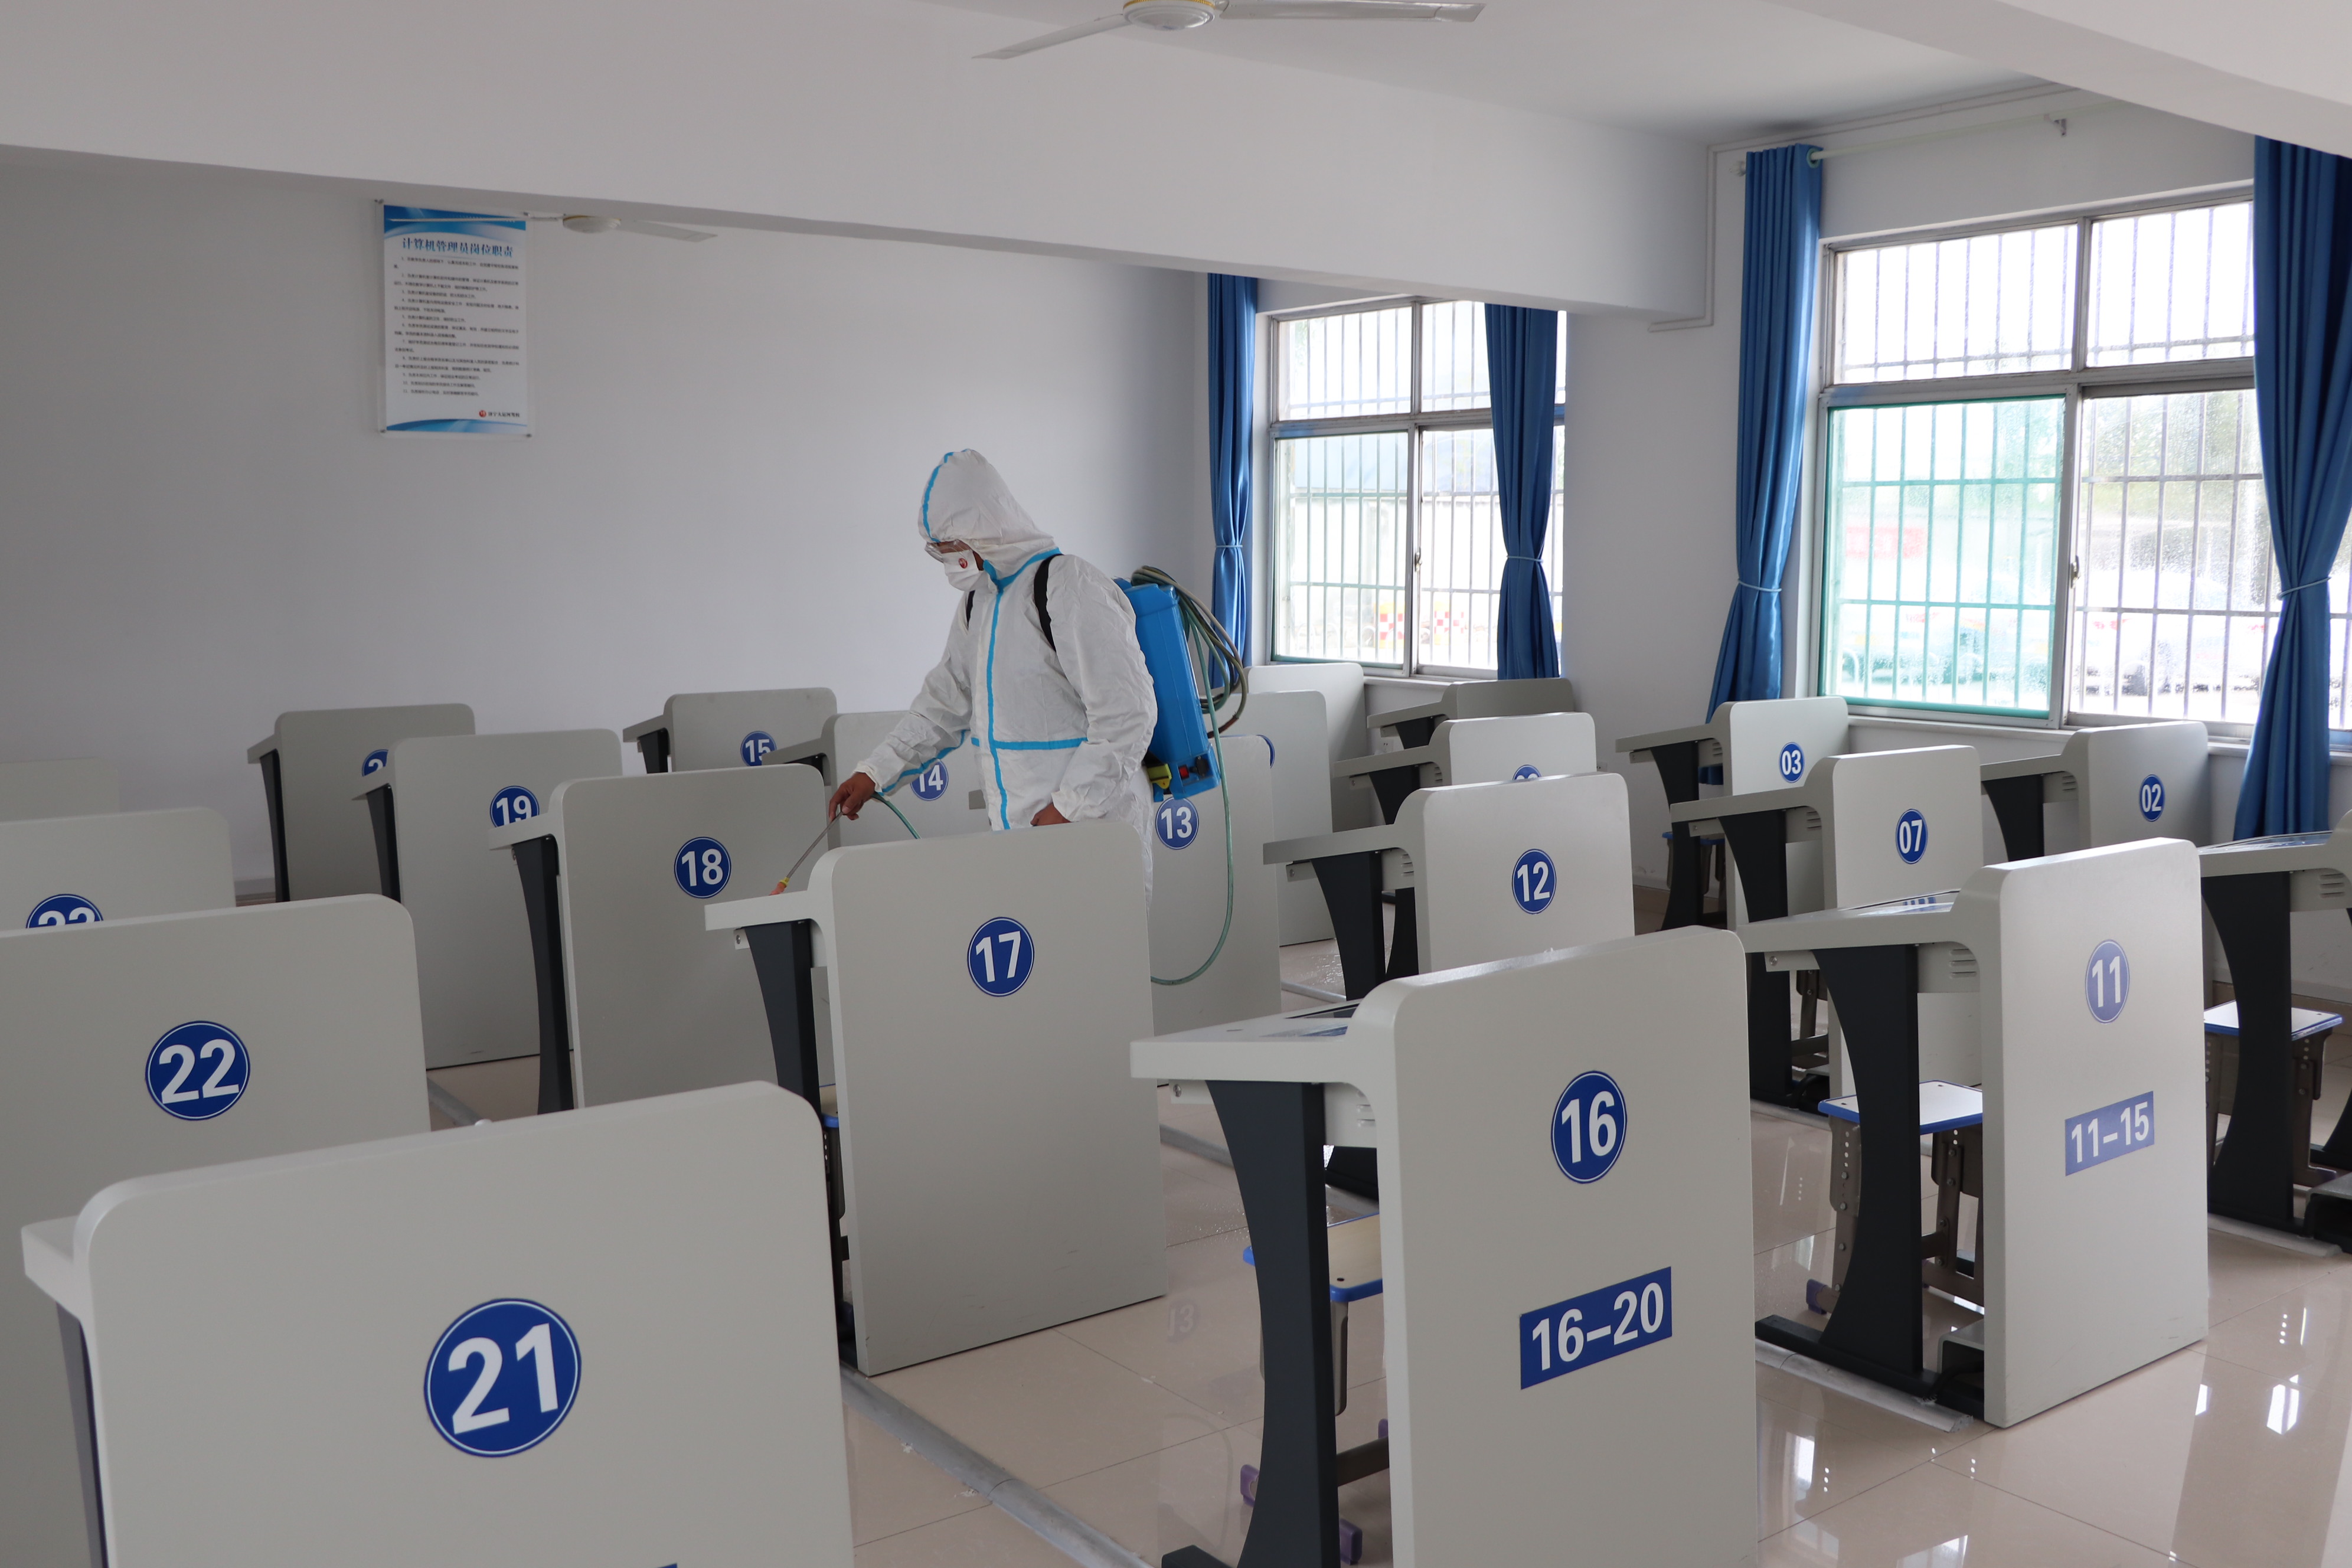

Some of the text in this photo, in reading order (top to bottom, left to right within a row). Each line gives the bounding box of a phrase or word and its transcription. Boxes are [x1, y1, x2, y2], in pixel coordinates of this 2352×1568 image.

[403, 237, 513, 257] 计算机管理员岗位职责
[745, 739, 770, 763] 15
[1781, 749, 1802, 775] 03
[919, 764, 944, 792] 14
[496, 795, 532, 825] 19
[2141, 783, 2162, 812] 02
[1161, 806, 1193, 839] 13
[1899, 819, 1923, 854] 07
[681, 848, 723, 887] 18
[1517, 861, 1550, 902] 12
[975, 930, 1021, 983] 17
[2092, 955, 2121, 1008] 11
[159, 1038, 240, 1104] 22
[1562, 1090, 1617, 1164] 16
[448, 1322, 558, 1435] 21
